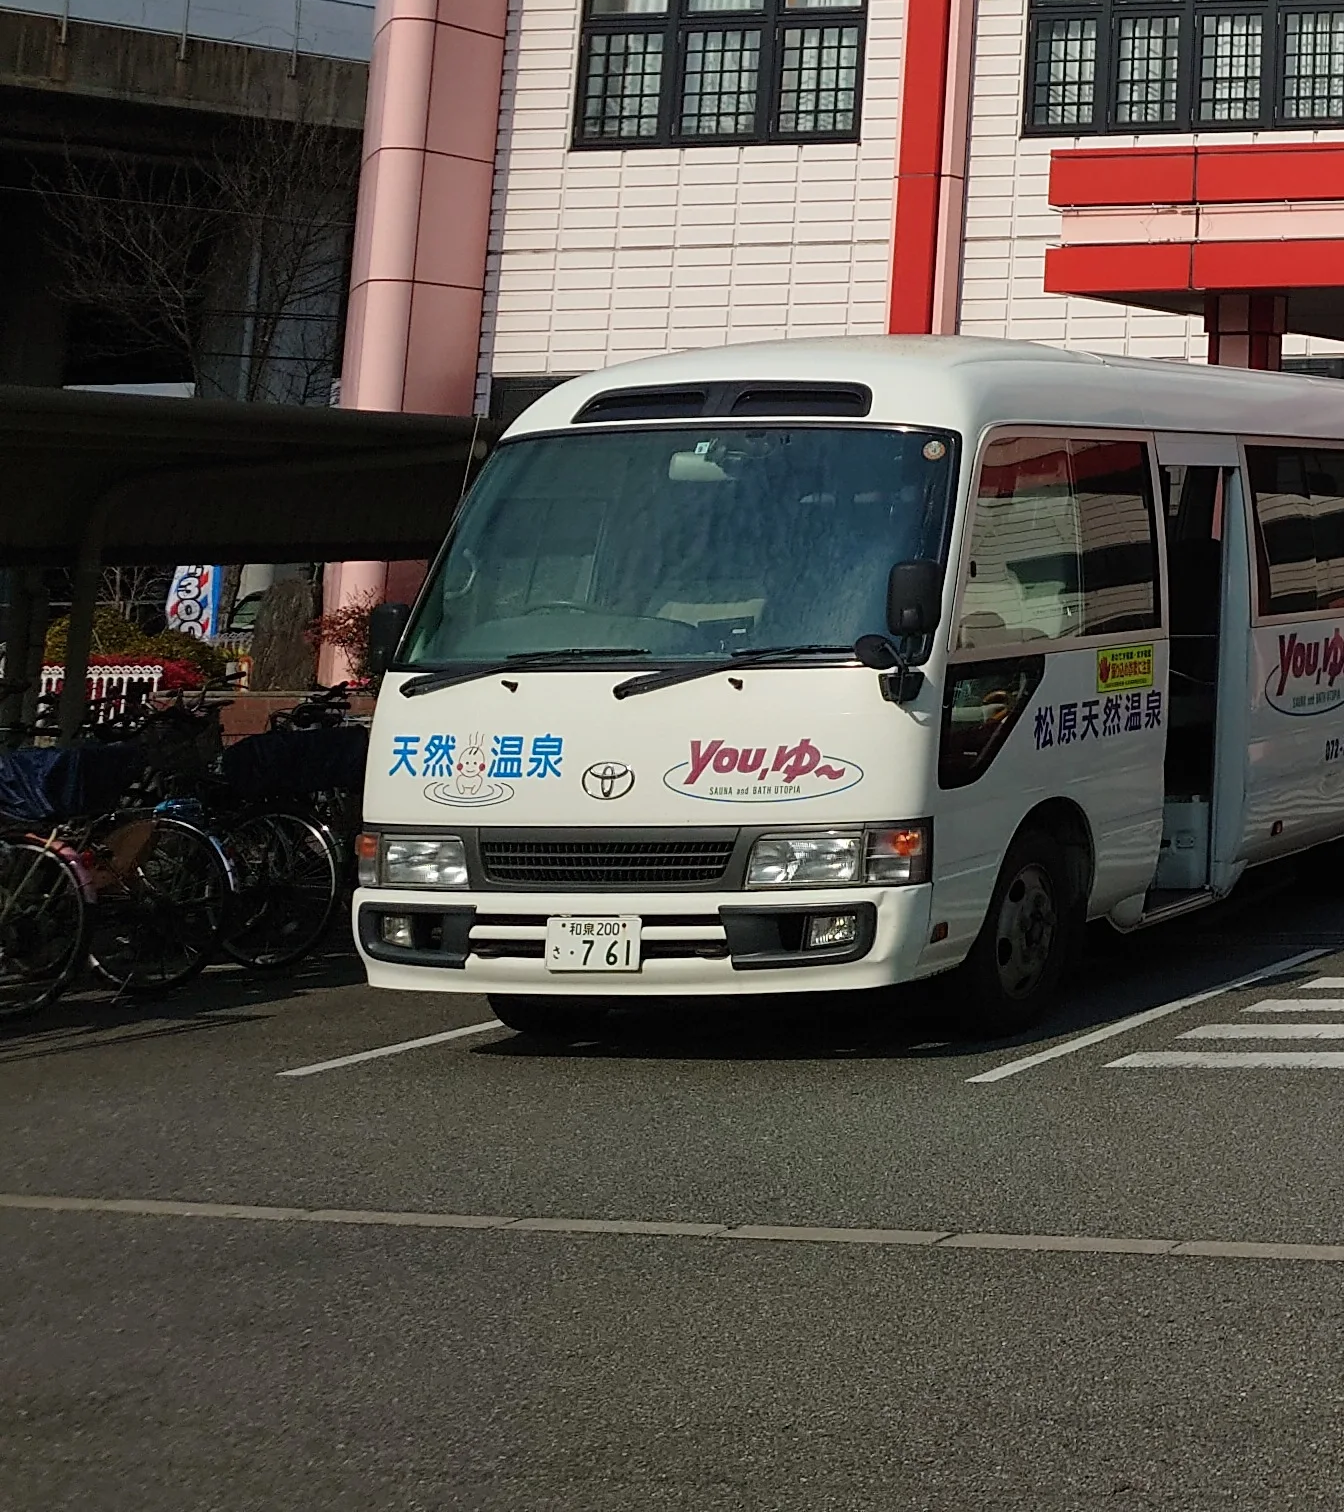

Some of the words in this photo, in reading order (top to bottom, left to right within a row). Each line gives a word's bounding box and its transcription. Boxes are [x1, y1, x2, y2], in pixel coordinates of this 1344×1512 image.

[1033, 689, 1162, 751] 松原天然温泉
[709, 787, 733, 796] SAUNA
[736, 787, 749, 795] and
[752, 786, 772, 795] BATH
[774, 785, 801, 795] UTOPIA
[569, 922, 620, 936] 和泉200
[552, 945, 561, 960] さ
